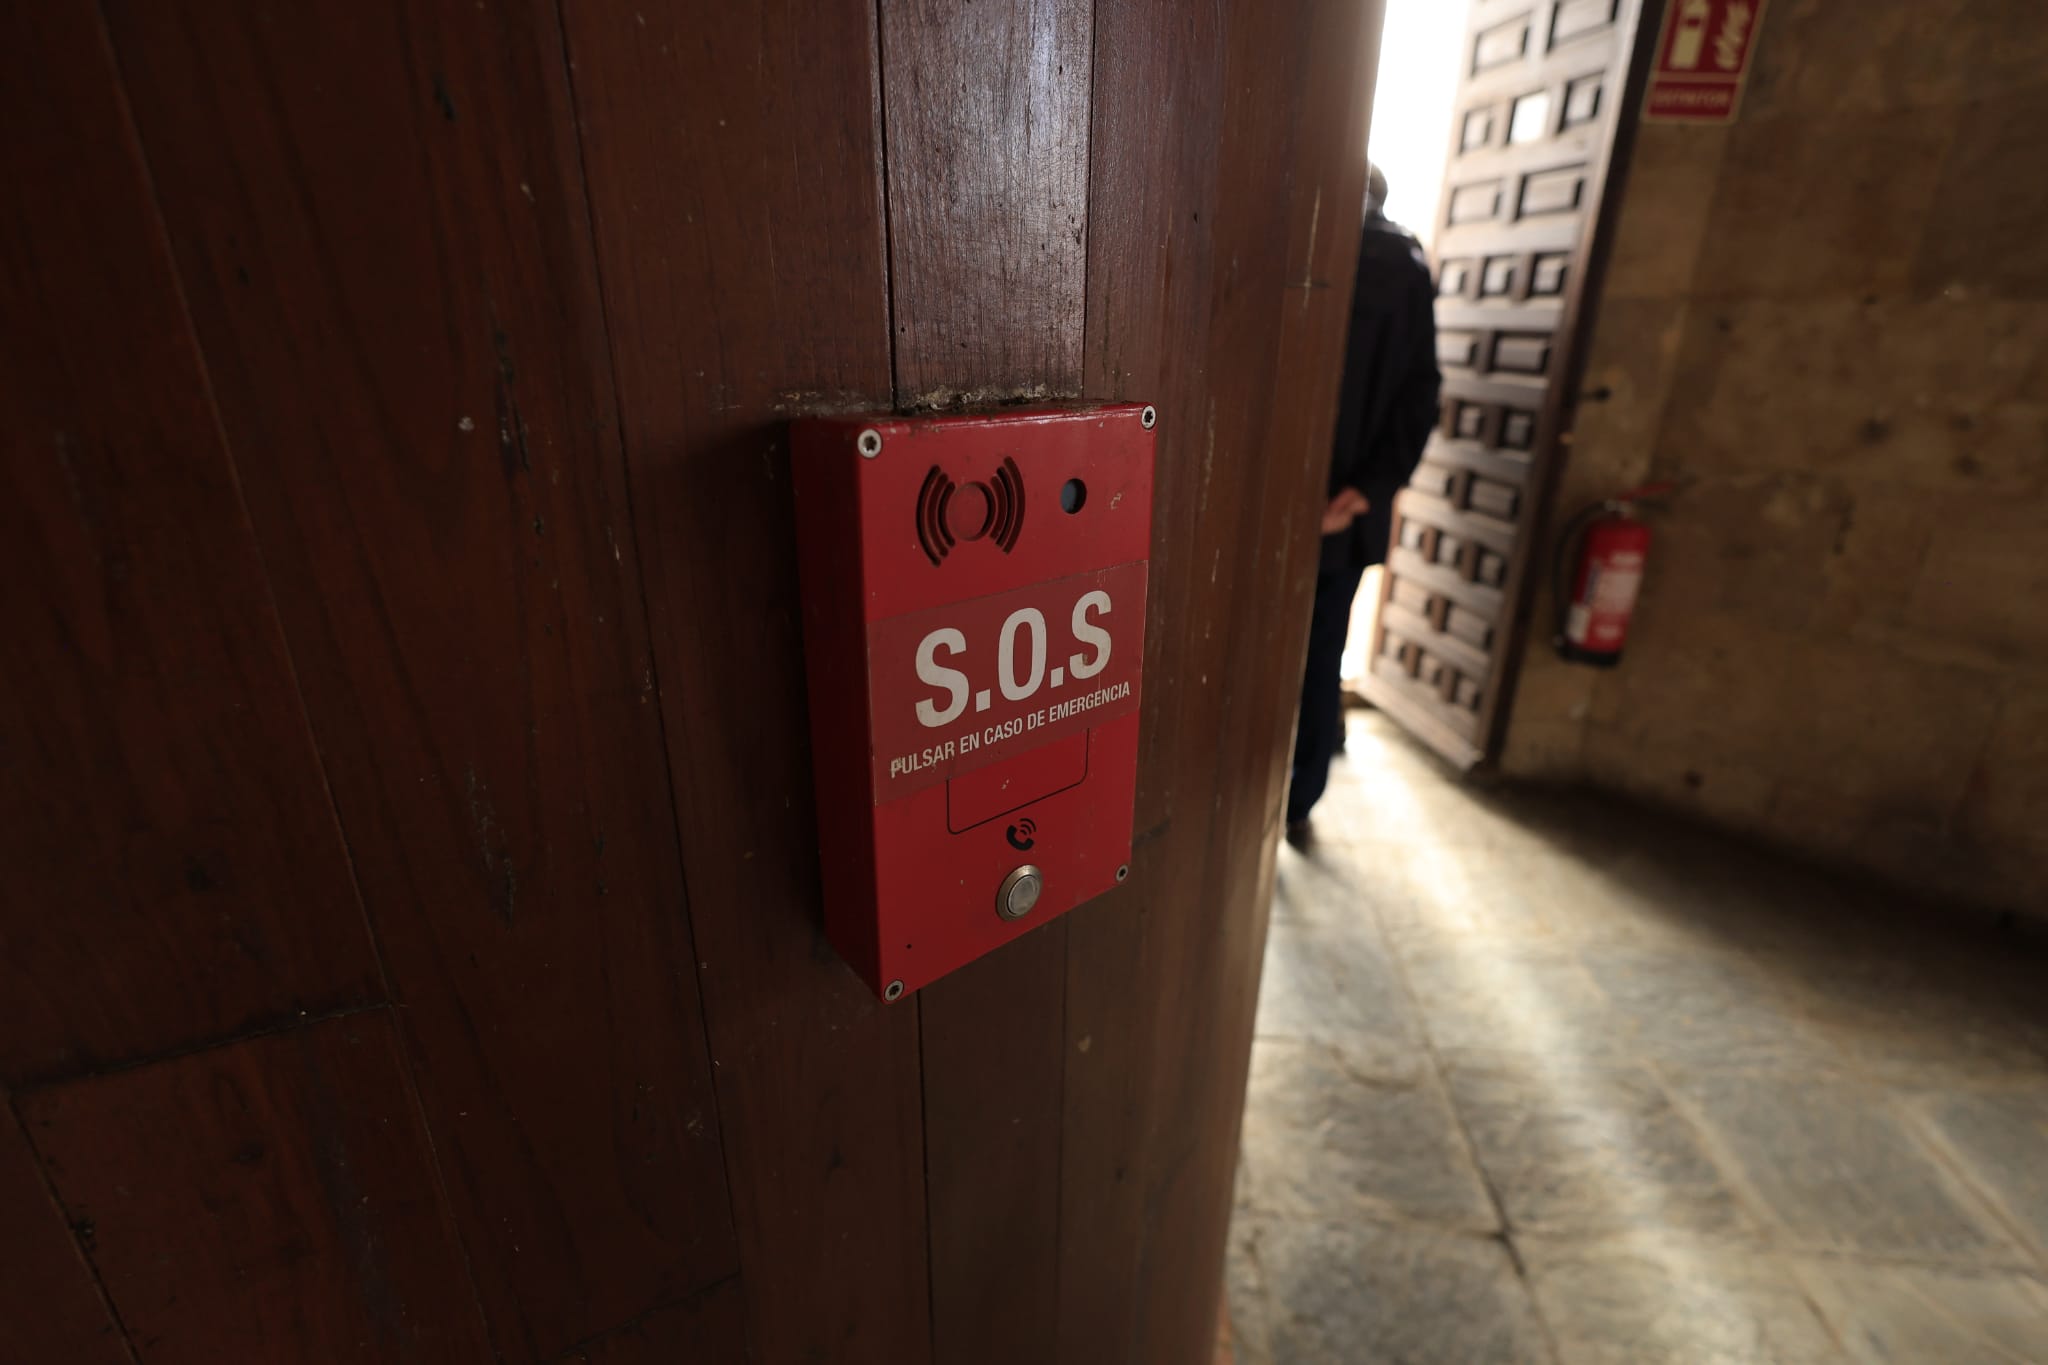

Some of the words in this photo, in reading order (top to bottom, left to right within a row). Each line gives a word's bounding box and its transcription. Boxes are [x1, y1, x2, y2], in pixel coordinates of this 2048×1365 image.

[915, 590, 1112, 727] S.O.S
[890, 741, 955, 778] PULSAR
[960, 732, 980, 754] EN
[984, 717, 1023, 745] CASO
[1027, 710, 1046, 730] DE
[1049, 681, 1131, 723] EMERGENCIA
